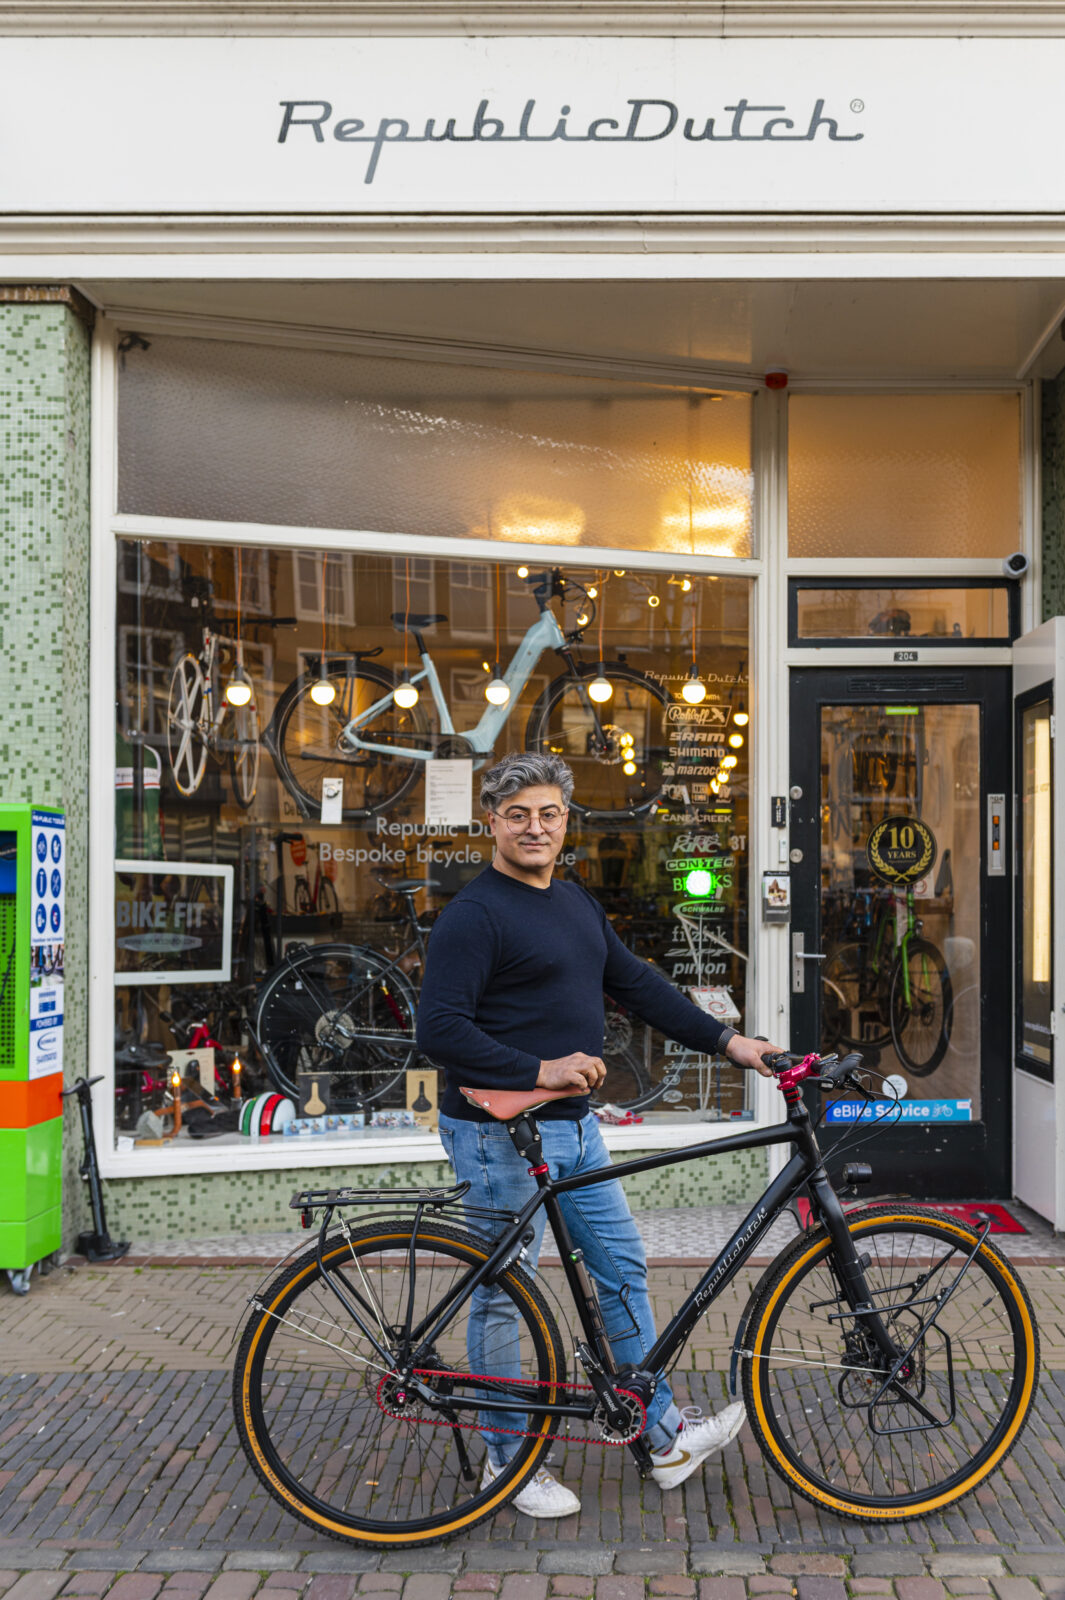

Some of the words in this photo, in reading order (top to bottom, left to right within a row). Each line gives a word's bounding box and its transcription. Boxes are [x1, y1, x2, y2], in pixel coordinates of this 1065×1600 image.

[898, 652, 913, 661] 204
[669, 732, 725, 743] SRAM
[669, 747, 725, 758] SHIMANO
[677, 765, 731, 776] marzocc
[662, 814, 691, 823] CANE
[697, 814, 732, 823] CREEK
[376, 817, 458, 840] Republic
[731, 835, 746, 851] 3T
[888, 826, 914, 849] 10
[320, 843, 406, 866] Bespoke
[416, 844, 482, 869] bicycle
[887, 851, 917, 859] YEARS
[117, 901, 167, 928] BIKE
[174, 902, 206, 928] FIT
[672, 962, 727, 978] pinion
[833, 1104, 873, 1118] eBike
[875, 1103, 931, 1118] Service
